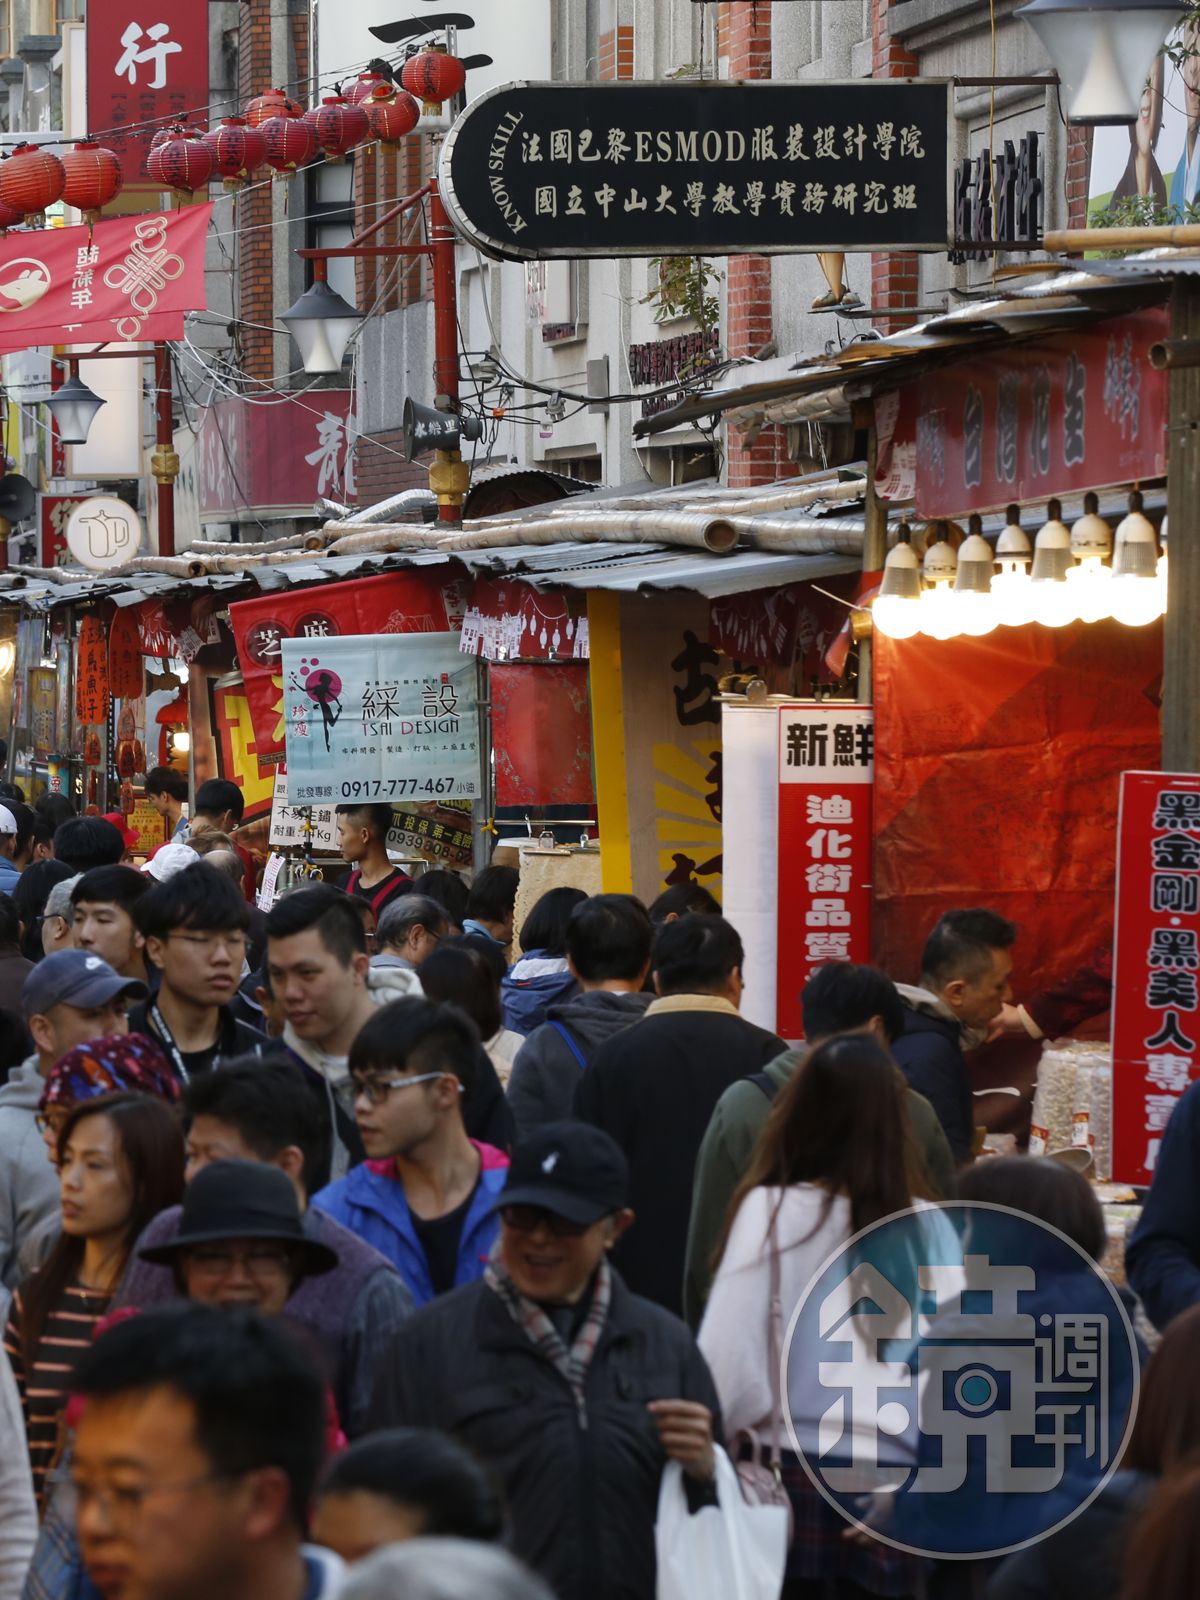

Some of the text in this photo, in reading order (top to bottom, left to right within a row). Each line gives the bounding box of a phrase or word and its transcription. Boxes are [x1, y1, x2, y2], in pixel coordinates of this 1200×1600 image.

[114, 21, 182, 89] 行
[489, 111, 528, 234] KNOW SKILL
[535, 182, 918, 219] 國立中山大學教學實務研究班
[362, 719, 460, 737] TSAI DESIGN
[787, 722, 874, 768] 新鮮
[341, 777, 454, 798] 0917-777-467
[804, 794, 854, 983] 迪化街品質
